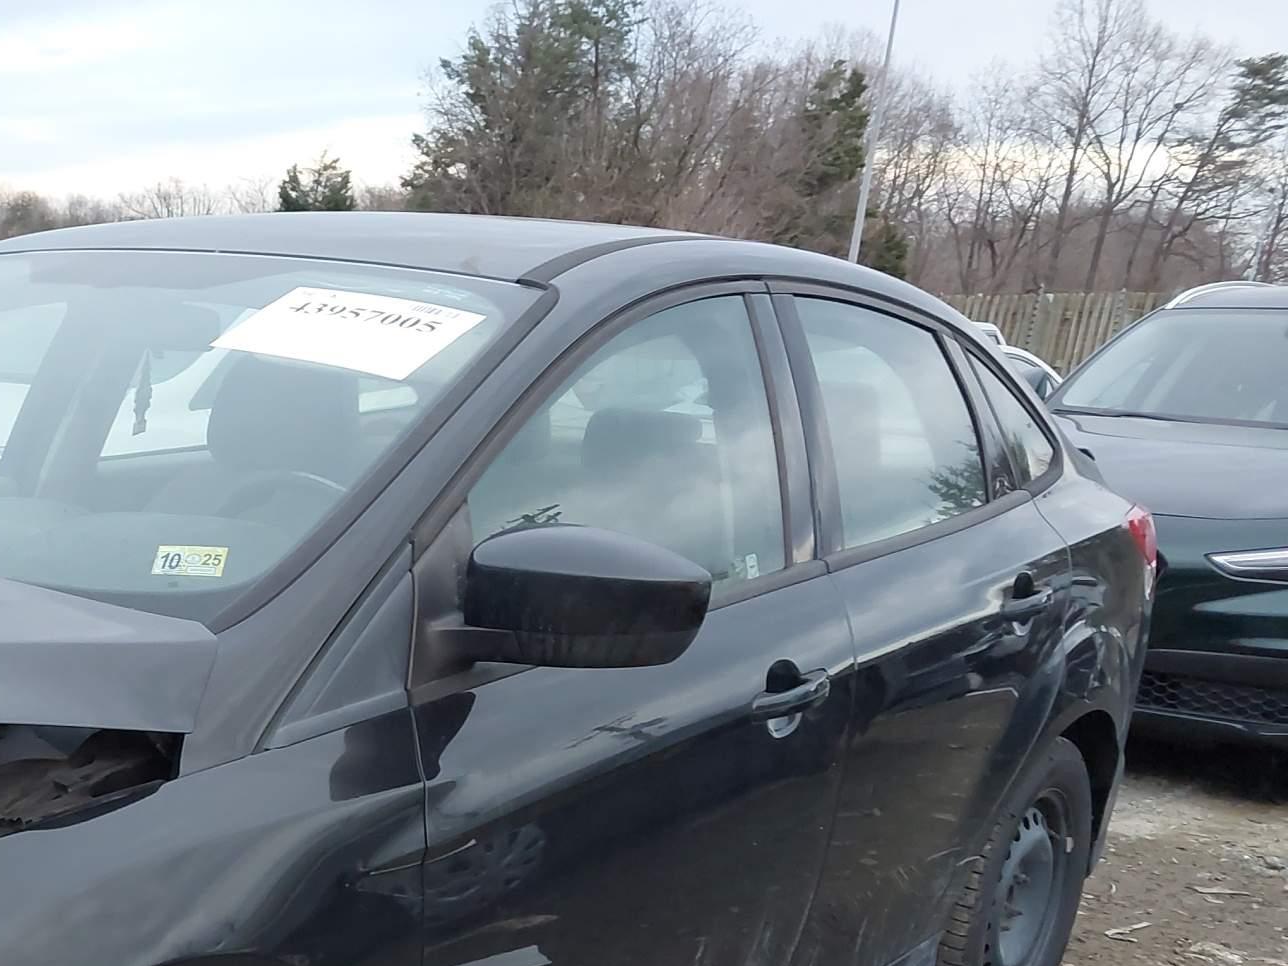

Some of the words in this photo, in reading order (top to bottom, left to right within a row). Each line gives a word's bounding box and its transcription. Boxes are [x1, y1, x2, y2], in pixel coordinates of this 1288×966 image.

[289, 302, 443, 332] 43957005
[160, 553, 182, 570] 10
[201, 553, 223, 567] 25
